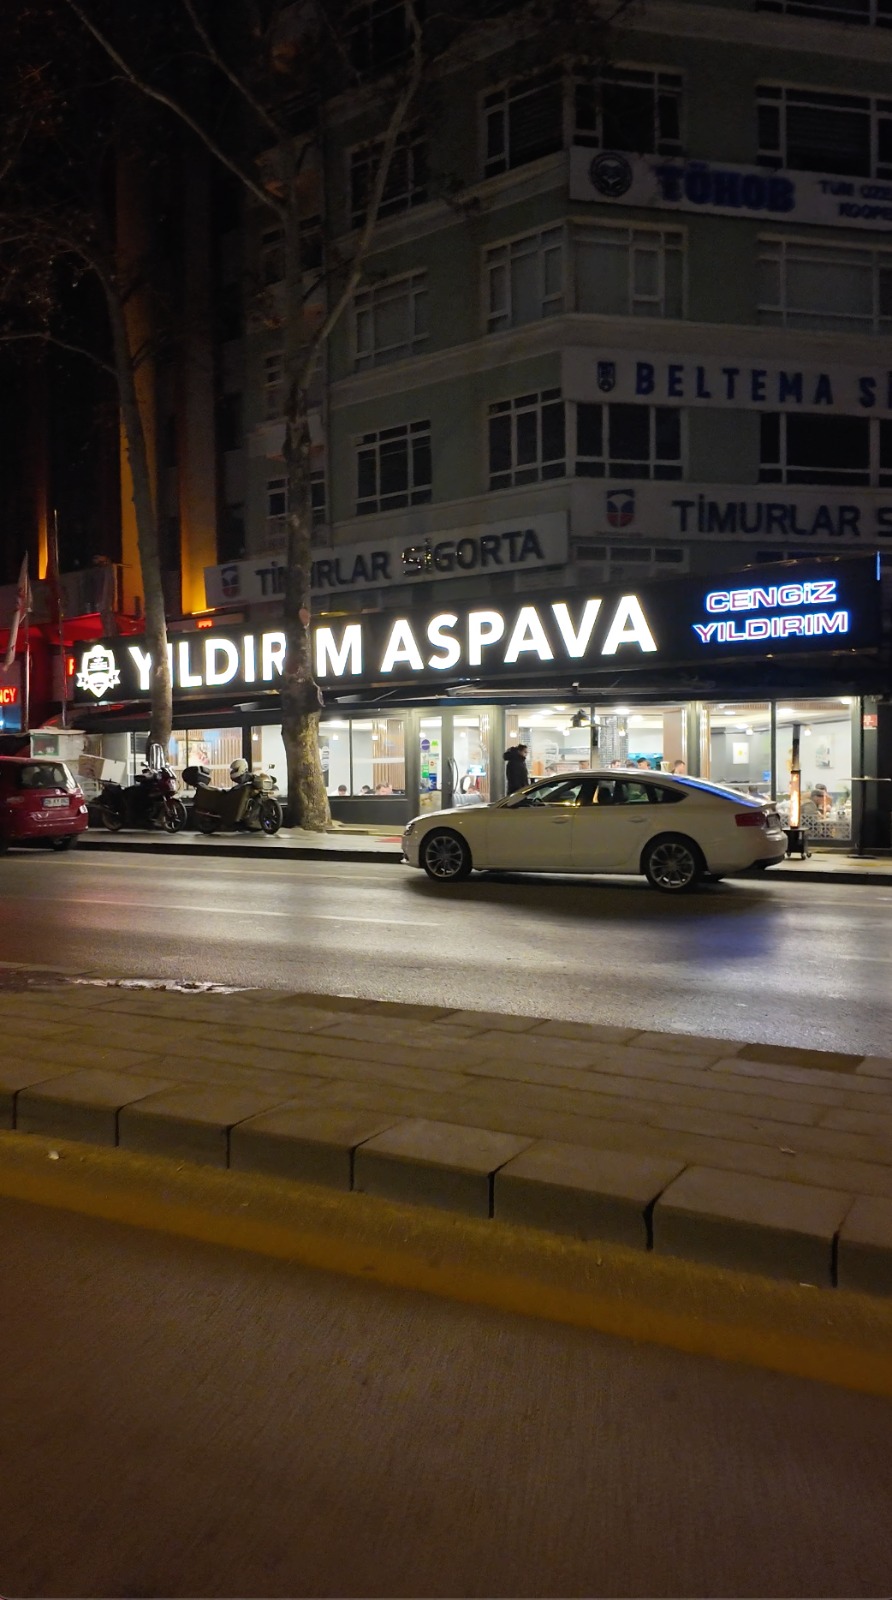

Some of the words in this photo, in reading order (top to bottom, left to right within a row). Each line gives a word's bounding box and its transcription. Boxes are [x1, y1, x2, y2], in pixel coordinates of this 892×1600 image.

[655, 161, 796, 213] TÖHOB
[635, 362, 834, 405] BELTEMA
[672, 494, 861, 537] TİMURLAR
[401, 529, 545, 576] SİGORTA
[380, 595, 658, 673] ASPAVA
[693, 611, 849, 643] YILDIRIM
